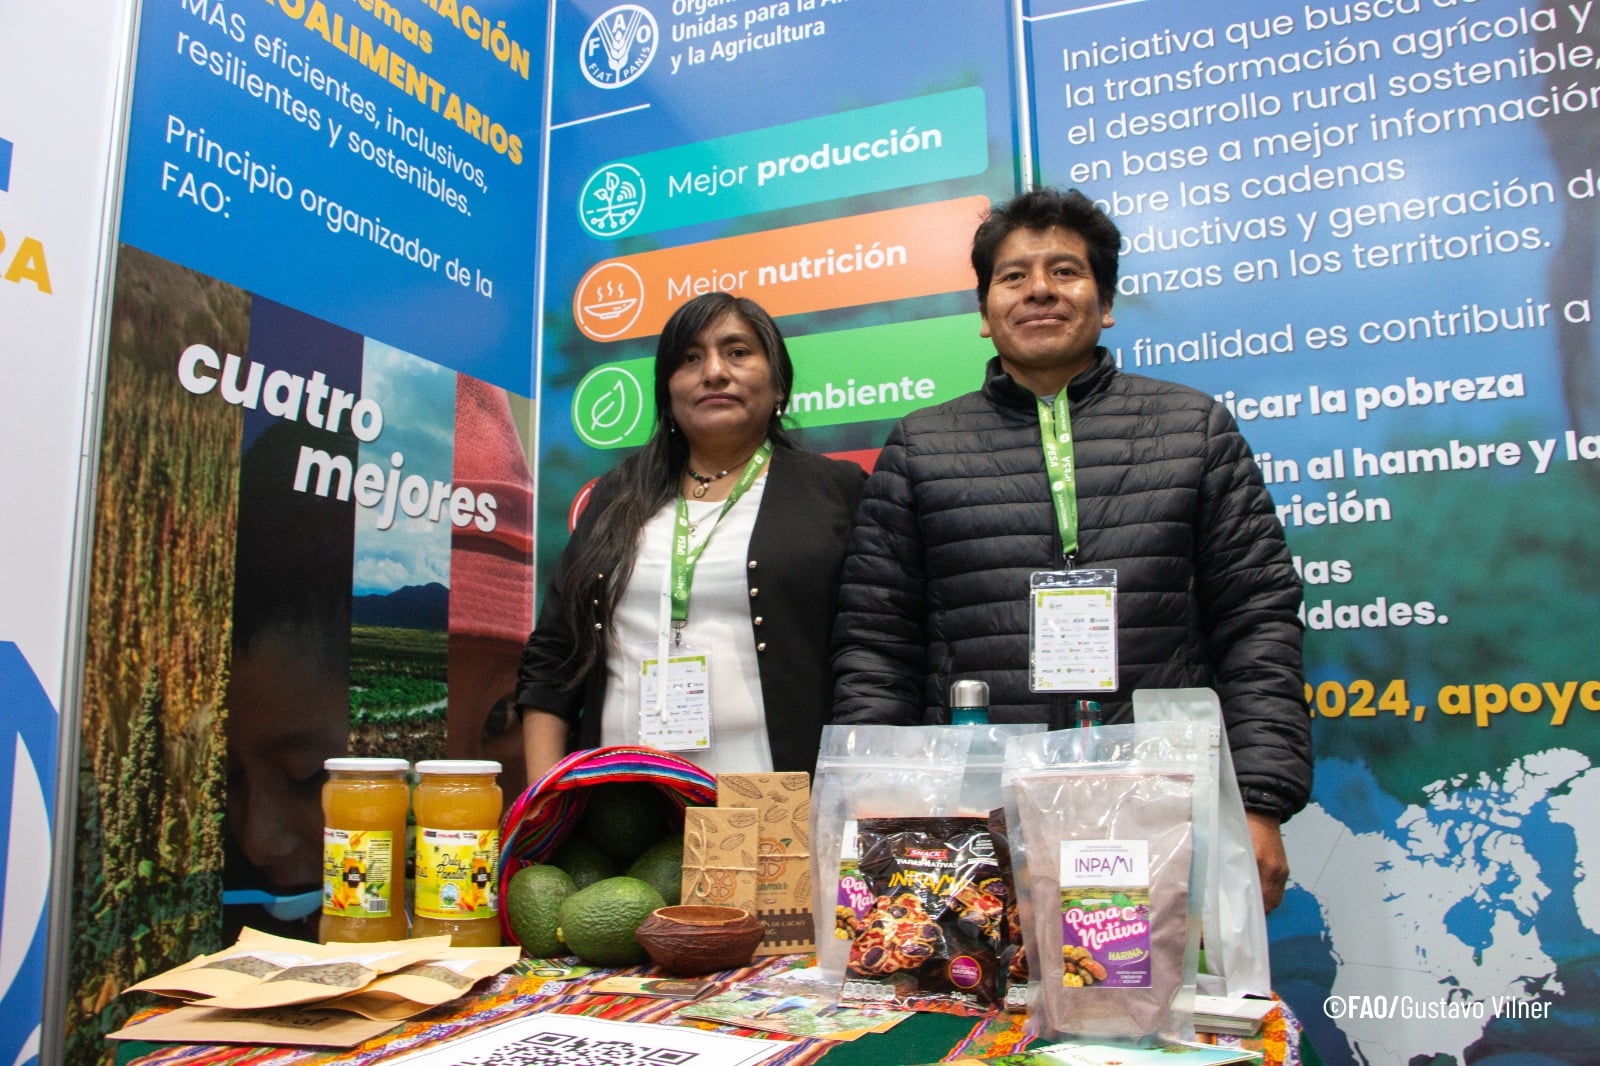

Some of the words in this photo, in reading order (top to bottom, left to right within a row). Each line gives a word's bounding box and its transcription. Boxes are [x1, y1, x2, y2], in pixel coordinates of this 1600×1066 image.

[670, 53, 682, 75] y
[687, 46, 705, 66] la
[710, 20, 826, 62] Agricultura
[672, 14, 738, 42] Unidas
[744, 1, 790, 30] para
[1062, 27, 1215, 72] Iniciativa
[1225, 13, 1294, 50] que
[1305, 0, 1421, 32] busca
[588, 62, 613, 82] FIAT
[623, 46, 650, 79] PANIS
[1065, 82, 1095, 109] la
[1104, 36, 1382, 99] transformación
[1392, 7, 1557, 60] agrícola
[1568, 0, 1593, 35] y
[177, 31, 321, 131] resilientes
[327, 117, 343, 148] y
[348, 131, 472, 217] sostenibles.
[254, 33, 381, 129] eficientes,
[386, 108, 488, 193] inclusivos,
[1067, 120, 1096, 146] el
[1105, 88, 1281, 140] desarrollo
[1293, 74, 1377, 112] rural
[668, 162, 748, 198] Mejor
[757, 126, 942, 186] producción
[1069, 160, 1112, 185] en
[1121, 141, 1208, 177] base
[1219, 140, 1243, 163] a
[1253, 121, 1360, 160] mejor
[161, 160, 231, 218] FAO:
[166, 114, 293, 200] Principio
[300, 187, 441, 270] organizador
[445, 257, 472, 288] de
[476, 268, 494, 298] la
[1092, 191, 1169, 217] obre
[1180, 181, 1231, 208] las
[1241, 155, 1406, 198] cadenas
[1117, 213, 1288, 257] oductivas
[1296, 212, 1318, 242] y
[1329, 177, 1555, 241] generación
[667, 267, 749, 301] Mejor
[757, 242, 908, 287] nutrición
[1117, 264, 1223, 296] anzas
[1233, 259, 1279, 284] en
[1289, 248, 1342, 278] los
[1352, 223, 1551, 268] territorios.
[1133, 324, 1294, 369] finalidad
[1305, 323, 1348, 350] es
[1359, 297, 1552, 345] contribuir
[1563, 298, 1591, 324] a
[176, 343, 384, 443] cuatro
[784, 376, 936, 414] mbiente
[1213, 390, 1303, 421] icar
[1308, 385, 1348, 415] la
[1355, 373, 1525, 421] pobreza
[1307, 449, 1345, 480] al
[1353, 435, 1522, 478] hambre
[1528, 437, 1557, 473] y
[1566, 430, 1600, 462] la
[293, 444, 498, 533] mejores
[1275, 489, 1392, 527] rición
[910, 849, 942, 858] SNACK
[1074, 855, 1133, 876] INPAMI
[1065, 905, 1121, 931] Papa
[1078, 921, 1148, 950] Nativa
